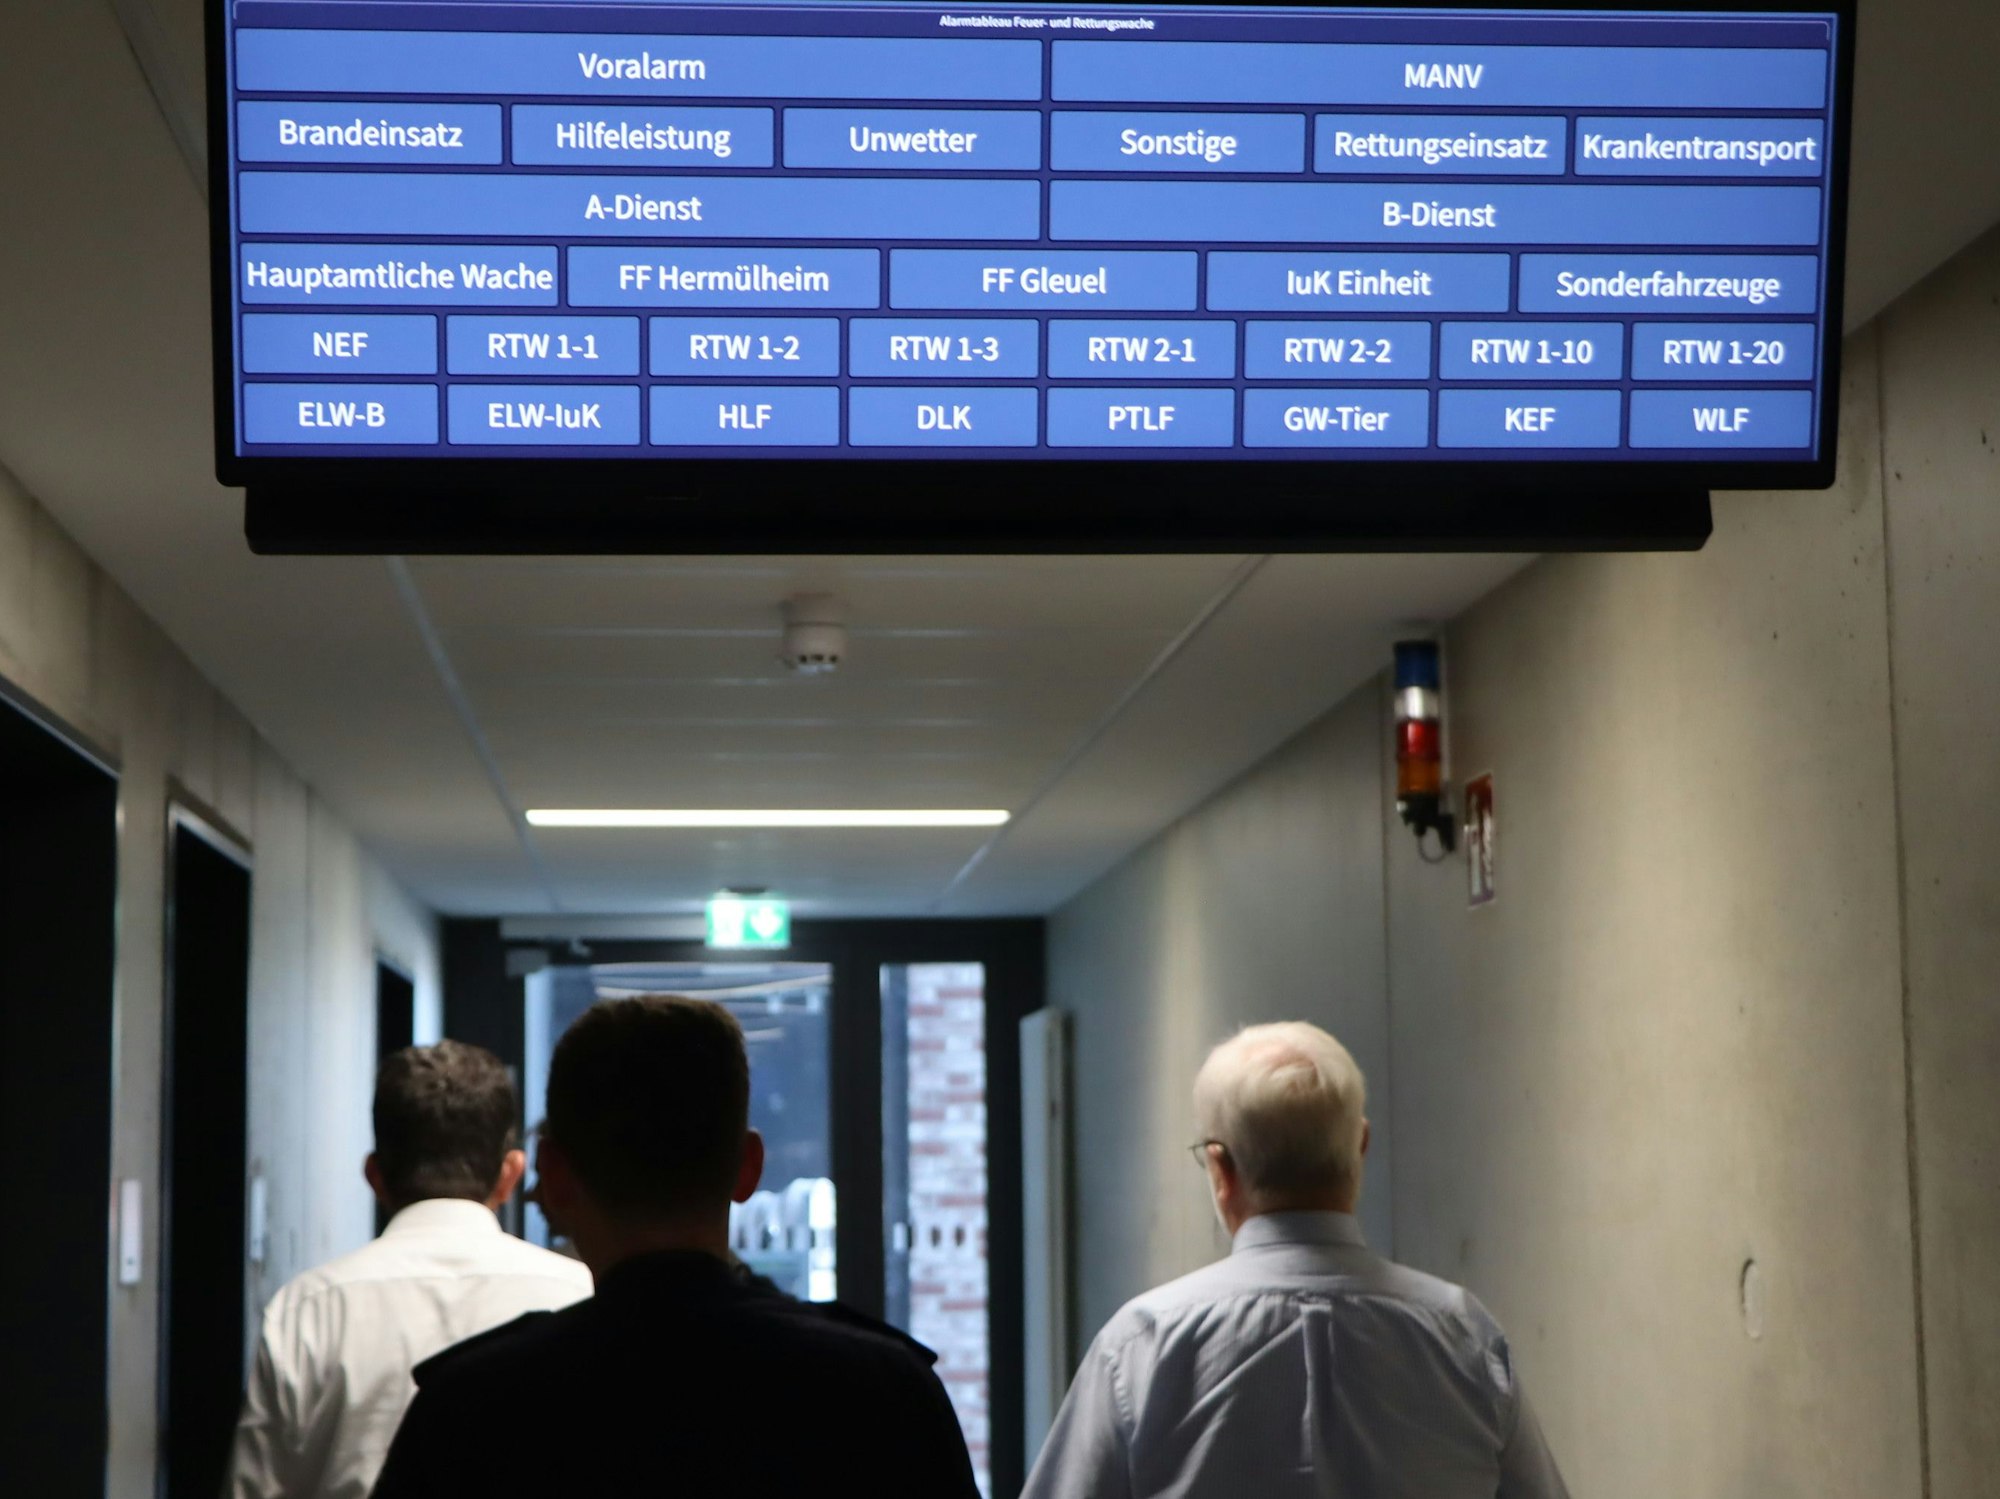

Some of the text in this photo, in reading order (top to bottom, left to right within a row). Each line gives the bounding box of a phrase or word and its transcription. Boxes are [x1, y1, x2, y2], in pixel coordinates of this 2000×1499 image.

[939, 15, 1154, 32] Alarmtableau Feuer- und Rettungswache
[579, 52, 705, 79] Voralarm
[1404, 64, 1483, 88] MANV
[279, 119, 463, 147] Brandeinsatz
[556, 122, 731, 158] Hilfeleistung
[849, 127, 977, 153] Unwetter
[1120, 129, 1237, 162] Sonstige
[1334, 132, 1548, 165] Rettungseinsatz
[1583, 133, 1816, 167] Krankentransport
[585, 194, 703, 220] A-Dienst
[1383, 201, 1496, 227] B-Dienst
[247, 261, 553, 293] Hauptamtliche Wache
[619, 264, 830, 291] FF Hermülheim
[982, 267, 1107, 293] FF Gleuel
[1287, 270, 1432, 296] IuK Einheit
[1556, 271, 1780, 304] Sonderfahrzeuge
[313, 333, 368, 358] NEF
[489, 334, 599, 358] RTW 1-1
[691, 335, 799, 359] RTW 1-2
[890, 336, 998, 361] RTW 1-3
[1088, 337, 1195, 362] RTW 2-1
[1284, 339, 1391, 363] RTW 2-2
[1471, 340, 1593, 364] RTW 1-10
[1663, 340, 1784, 365] RTW 1-20
[298, 402, 386, 427] ELW-B
[488, 403, 601, 428] ELW-IuK
[720, 405, 772, 429] HLF
[918, 405, 972, 429] DLK
[1108, 406, 1175, 430] PTLF
[1284, 406, 1390, 431] GW-Tier
[1505, 407, 1556, 431] KEF
[1692, 407, 1750, 431] WLF
